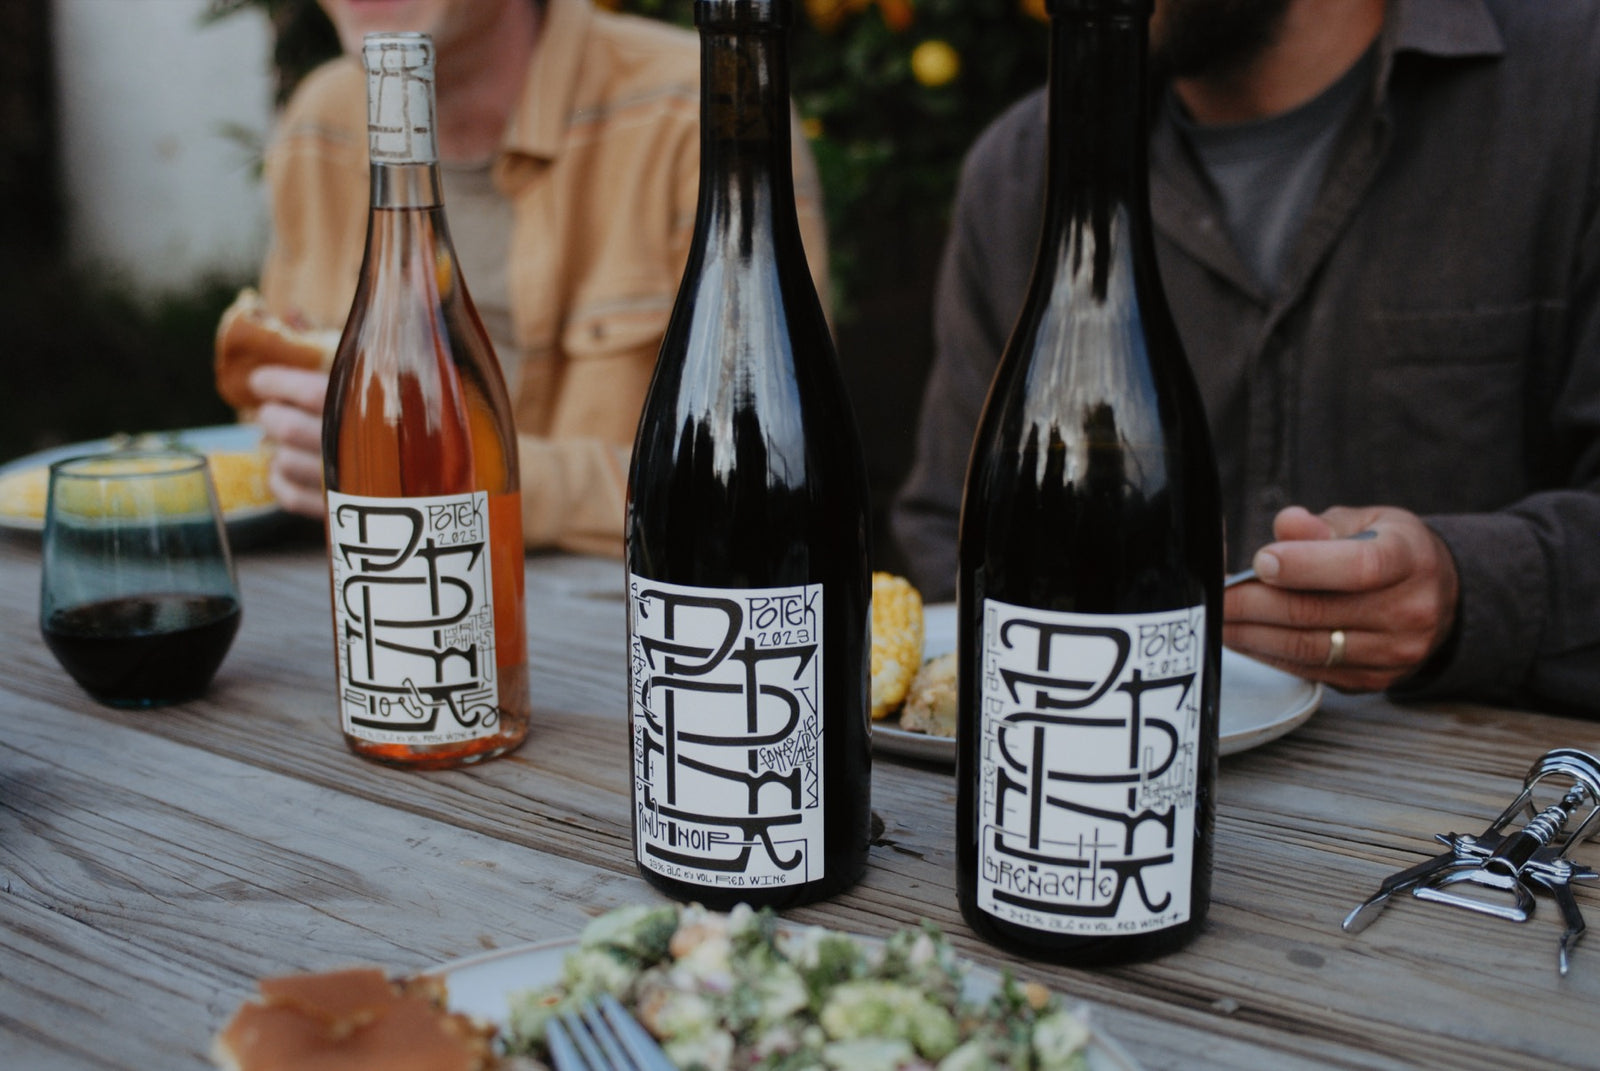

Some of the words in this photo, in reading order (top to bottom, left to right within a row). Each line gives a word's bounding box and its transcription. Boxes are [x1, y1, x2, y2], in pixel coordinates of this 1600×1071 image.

[425, 494, 485, 535] POTEK
[438, 529, 478, 546] 2025
[745, 586, 819, 638] POTEK
[757, 629, 810, 647] 2023
[638, 799, 668, 842] PINOT
[750, 874, 787, 886] WINE
[983, 838, 1113, 902] GRENACHE
